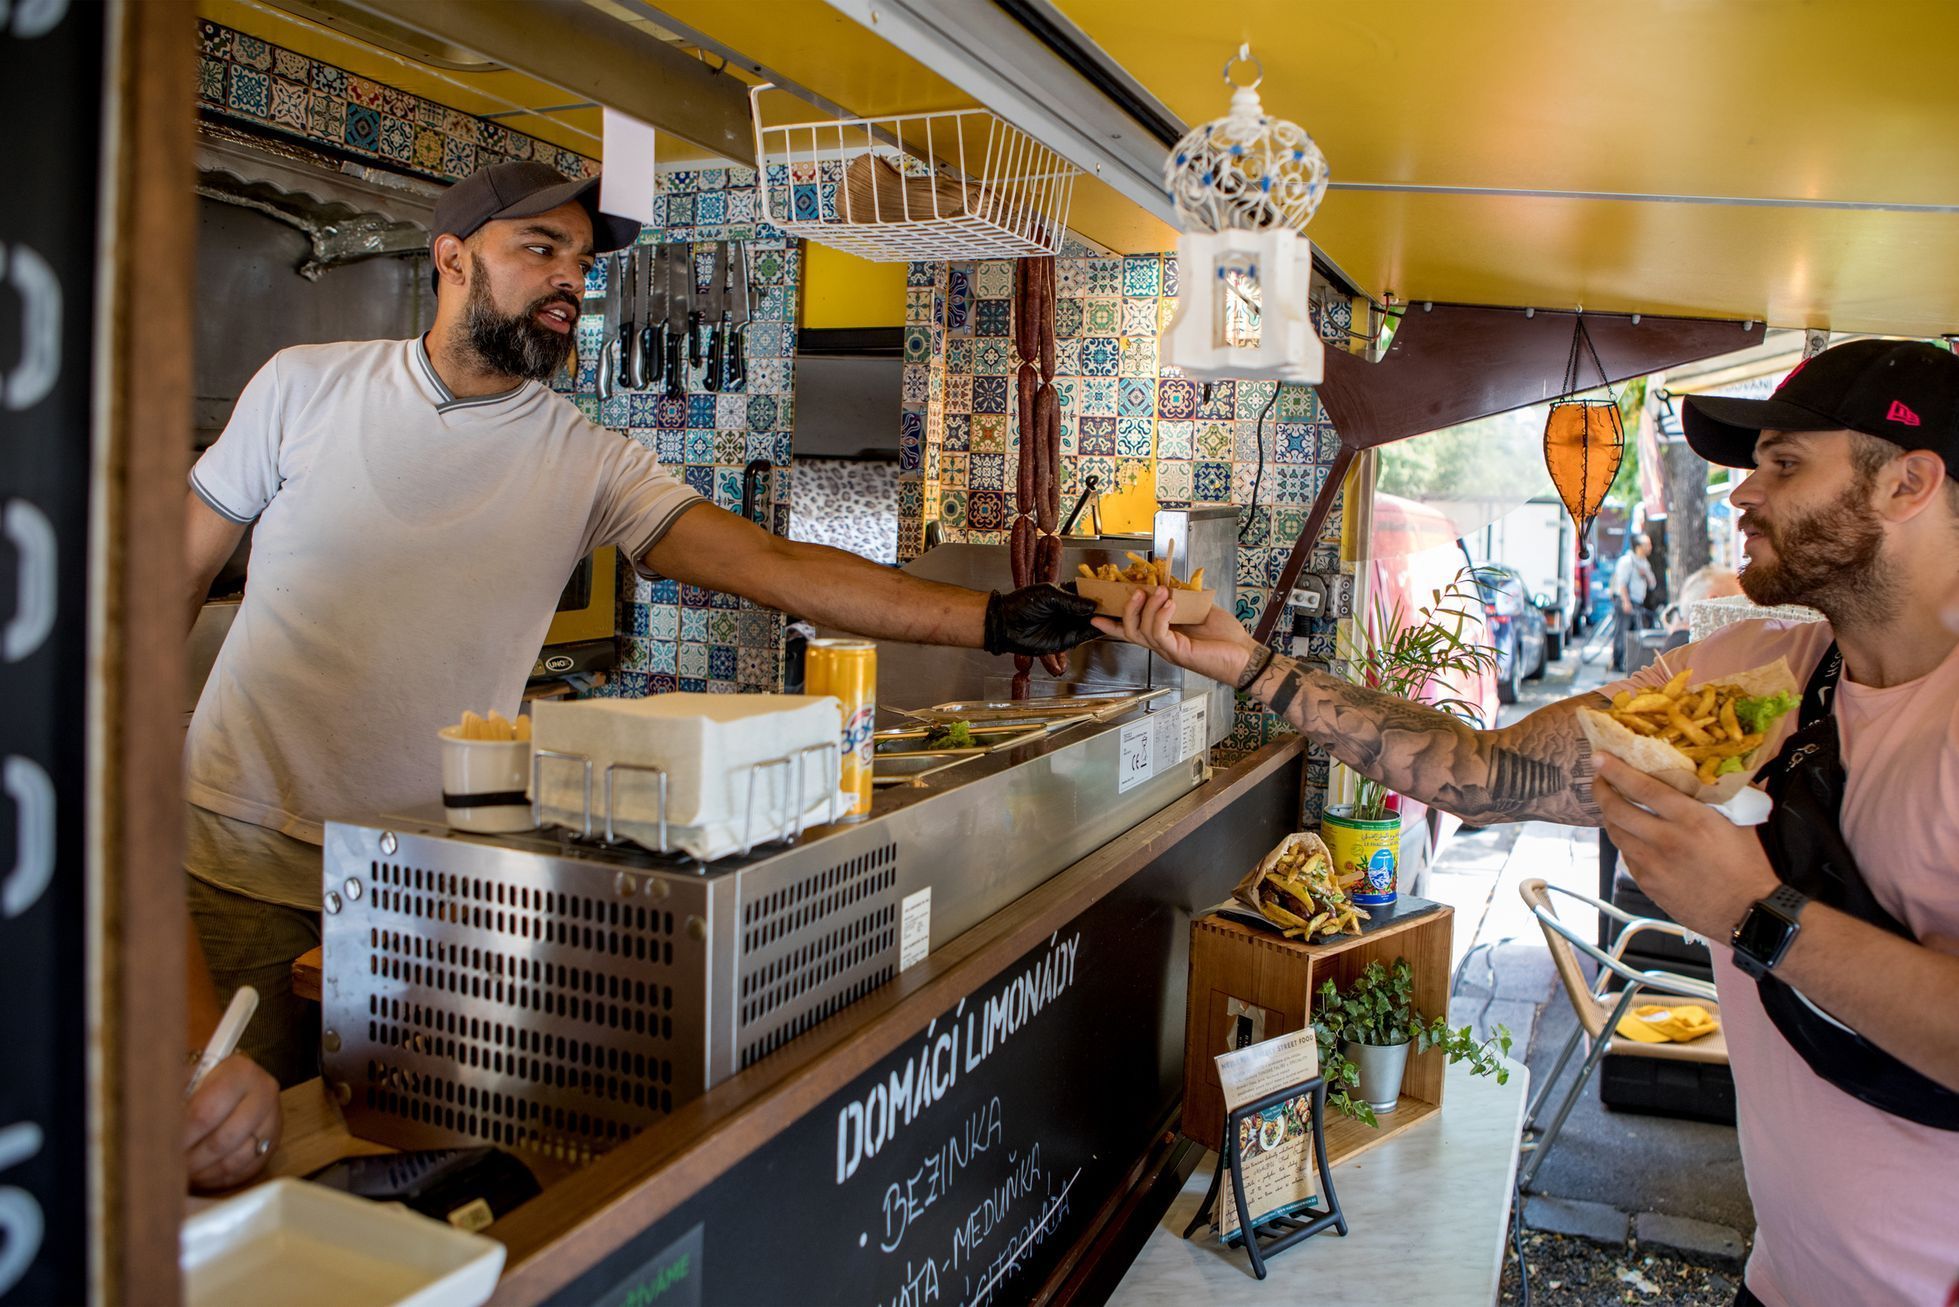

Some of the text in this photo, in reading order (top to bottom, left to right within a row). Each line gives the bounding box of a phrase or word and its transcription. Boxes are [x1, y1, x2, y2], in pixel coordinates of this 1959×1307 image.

[837, 997, 965, 1185] DOMÁCÍ
[965, 930, 1080, 1074] LIMONÁDY
[1277, 1034, 1314, 1052] STREET FOOD
[880, 1096, 1002, 1253] BEZINKA
